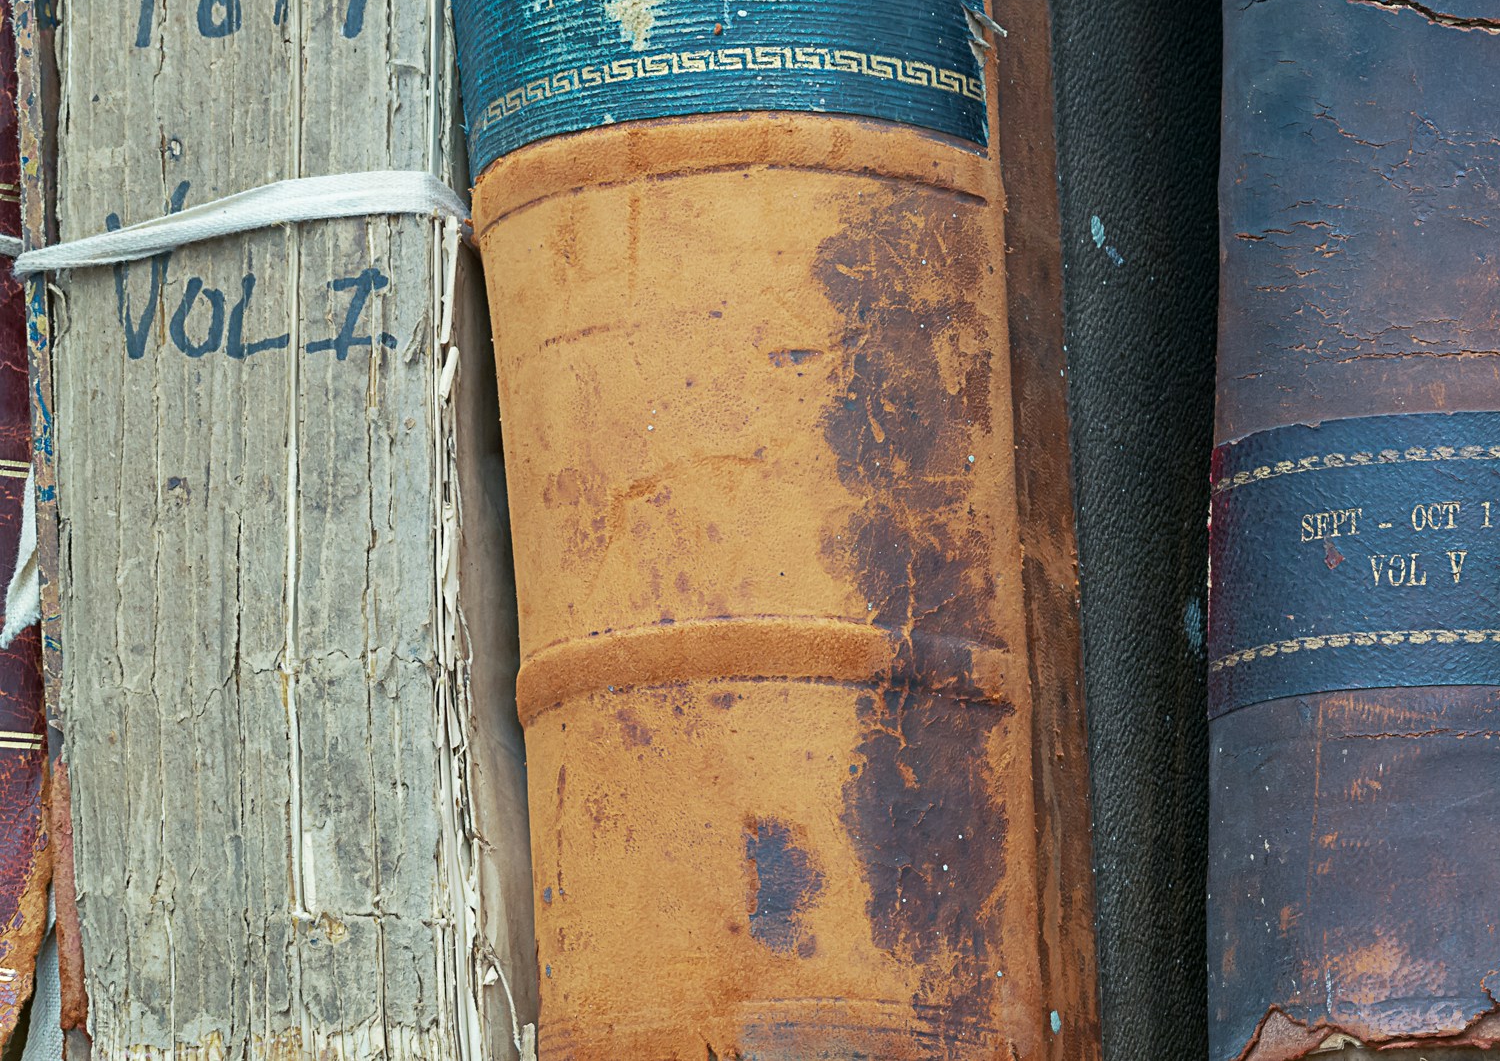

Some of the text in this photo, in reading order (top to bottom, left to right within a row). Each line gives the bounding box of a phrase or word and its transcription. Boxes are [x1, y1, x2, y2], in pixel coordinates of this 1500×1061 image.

[1411, 501, 1461, 532] OCT
[1368, 550, 1468, 587] VOL V
